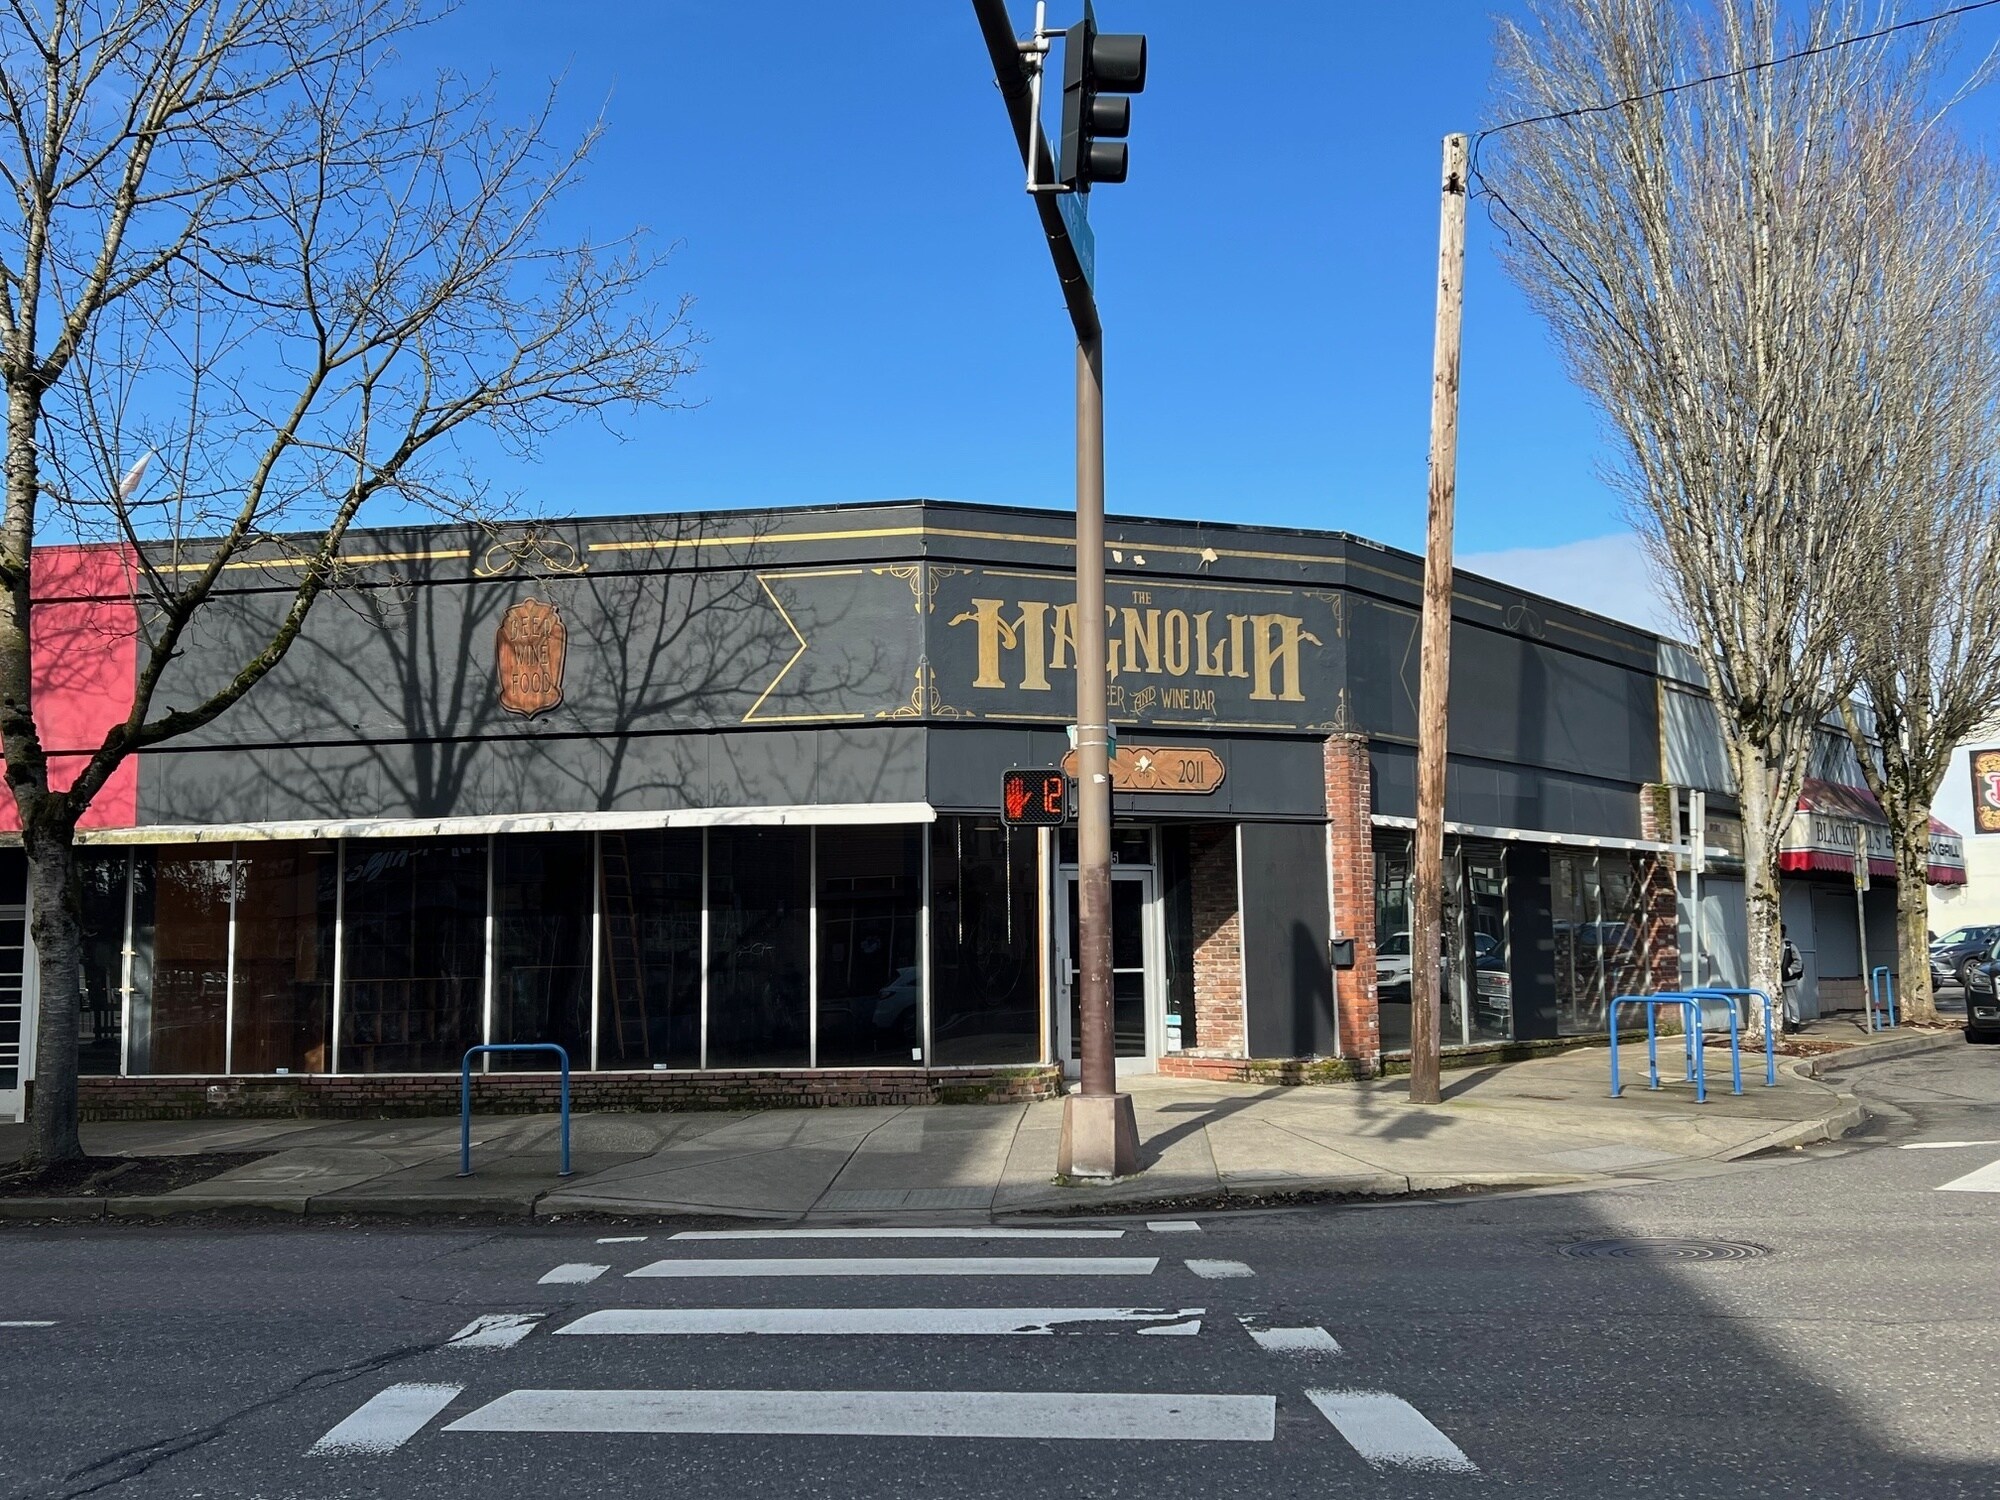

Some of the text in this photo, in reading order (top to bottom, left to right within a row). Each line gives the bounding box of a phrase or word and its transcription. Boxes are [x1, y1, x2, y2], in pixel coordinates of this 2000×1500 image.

[1132, 590, 1151, 604] THE
[510, 616, 552, 642] BEER
[514, 644, 550, 667] WINE
[512, 672, 552, 695] FOOD
[1129, 685, 1157, 717] AND
[1161, 688, 1190, 709] WINE
[1193, 689, 1217, 716] BAR
[1178, 759, 1204, 784] 2011
[1938, 843, 1960, 858] GRILL
